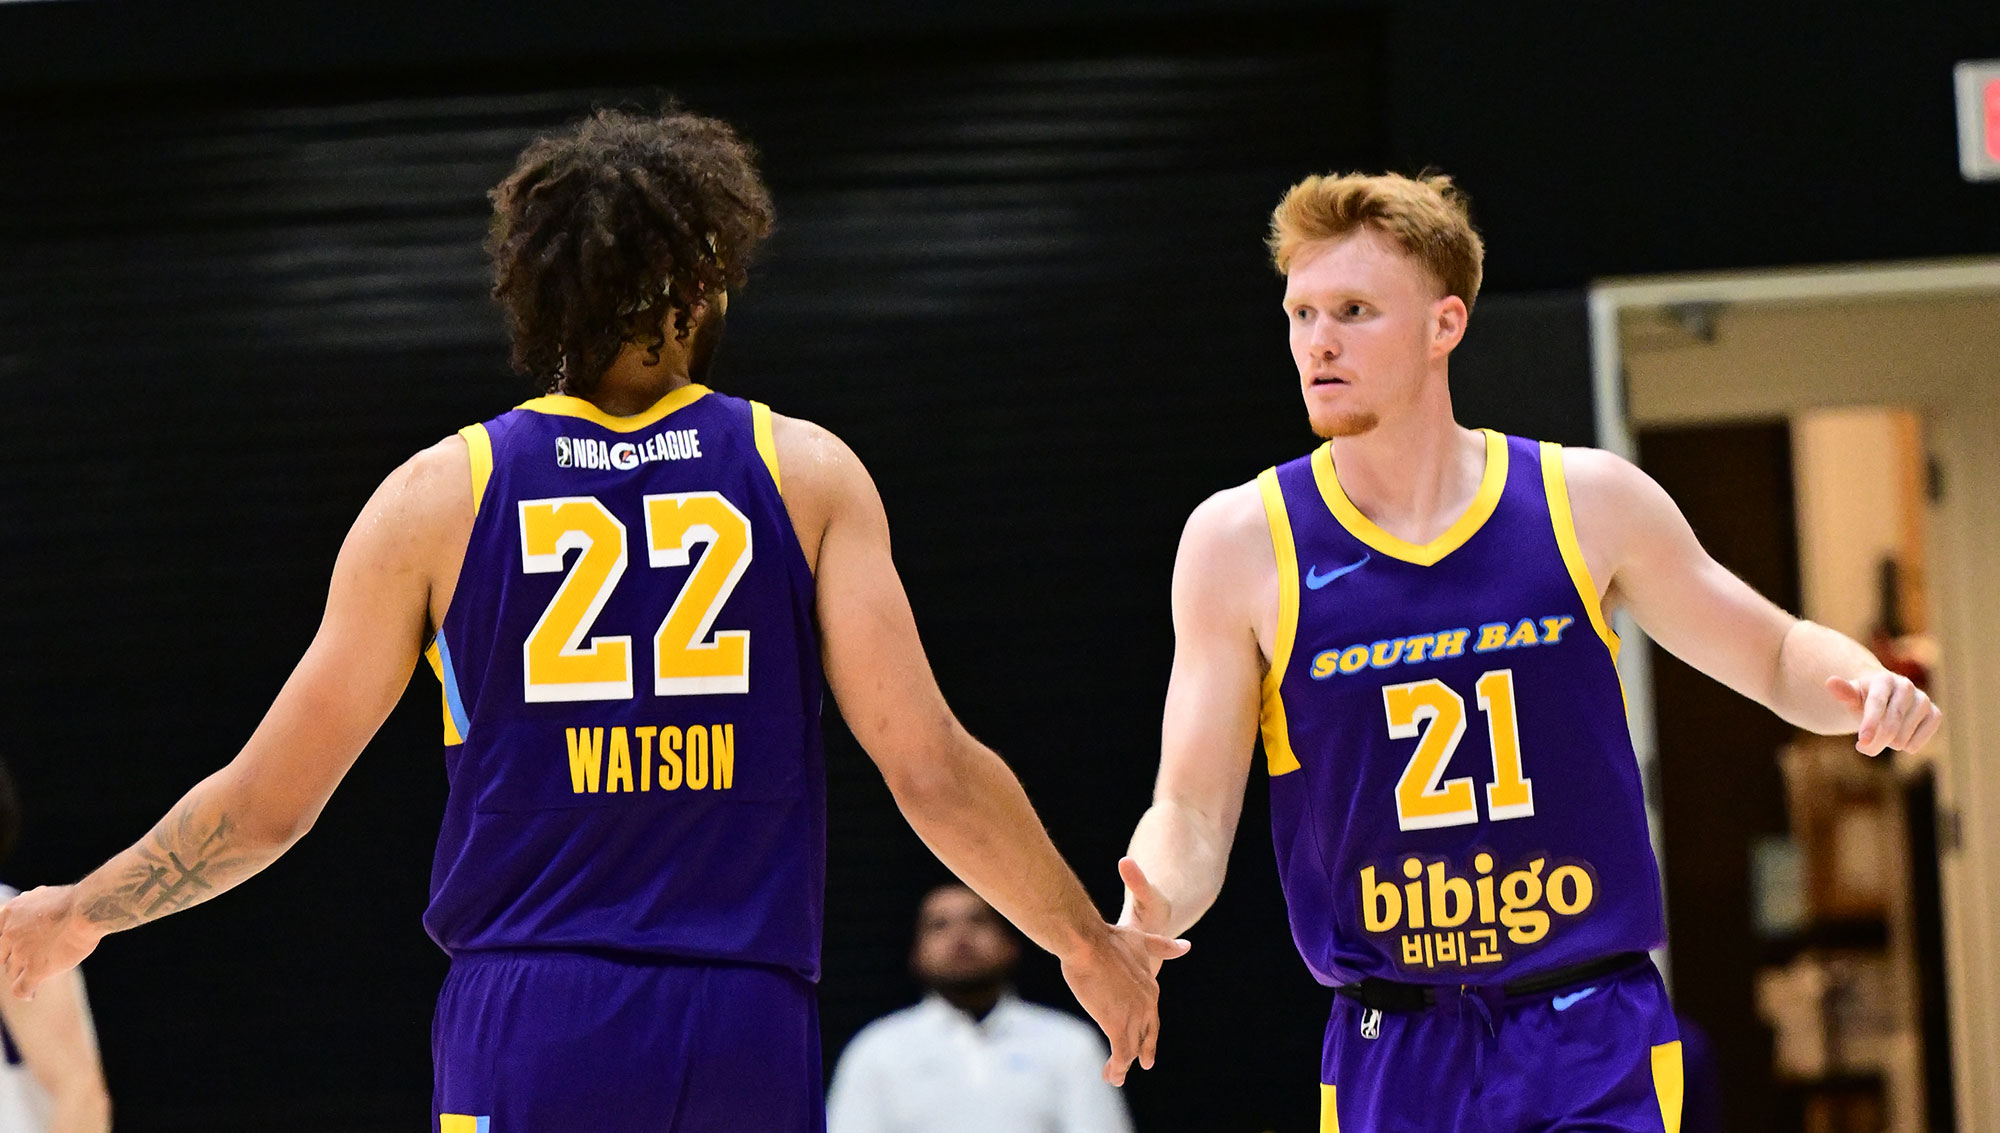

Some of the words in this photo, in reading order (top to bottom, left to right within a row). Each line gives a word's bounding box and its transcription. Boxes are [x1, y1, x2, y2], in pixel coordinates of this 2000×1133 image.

[573, 438, 610, 470] NBA
[638, 429, 702, 463] LEAGUE
[518, 491, 752, 702] 22
[1310, 628, 1470, 680] SOUTH
[1473, 615, 1574, 654] BAY
[565, 723, 734, 793] WATSON
[1382, 669, 1534, 831] 21
[1360, 853, 1593, 944] bibigo
[1401, 929, 1503, 968] 비비고
